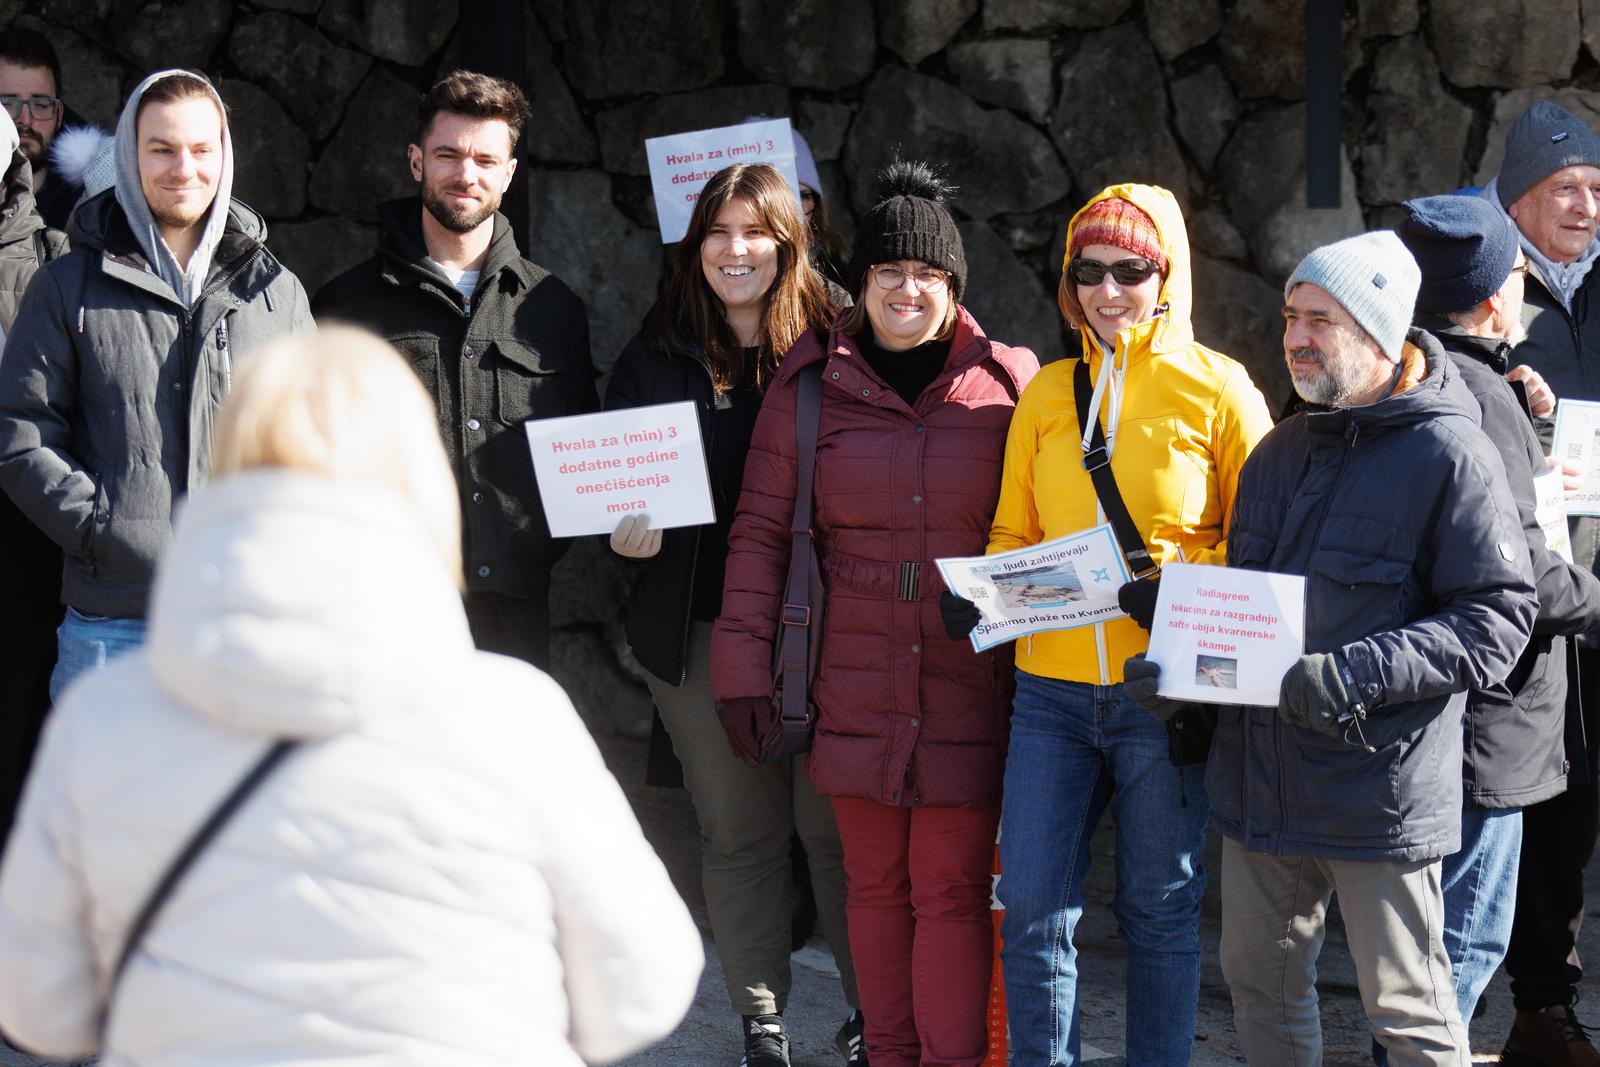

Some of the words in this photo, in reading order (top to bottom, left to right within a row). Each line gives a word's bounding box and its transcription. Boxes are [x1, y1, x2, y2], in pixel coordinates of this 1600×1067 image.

[666, 152, 704, 165] Hvala
[708, 149, 723, 159] za
[727, 142, 761, 158] (min)
[766, 140, 774, 150] 3
[672, 171, 717, 184] dodatn
[551, 438, 596, 453] Hvala
[601, 436, 618, 447] za
[623, 428, 663, 446] (min)
[668, 426, 677, 438] 3
[559, 458, 622, 474] dodatne
[626, 450, 679, 468] godine
[576, 473, 670, 494] onečišćenja
[606, 499, 647, 513] mora
[1003, 559, 1028, 572] ljudi
[1030, 543, 1089, 566] zahtijevaju
[1196, 587, 1250, 603] Radiagreen
[976, 617, 1026, 635] Spasimo
[1028, 613, 1059, 625] plaže
[1062, 611, 1076, 620] na
[1078, 604, 1119, 618] Kvarne
[1210, 608, 1221, 616] za
[1223, 610, 1277, 625] razgradnju
[1192, 622, 1215, 633] ubija
[1218, 625, 1276, 641] kvarnerske
[1197, 639, 1237, 653] škampe
